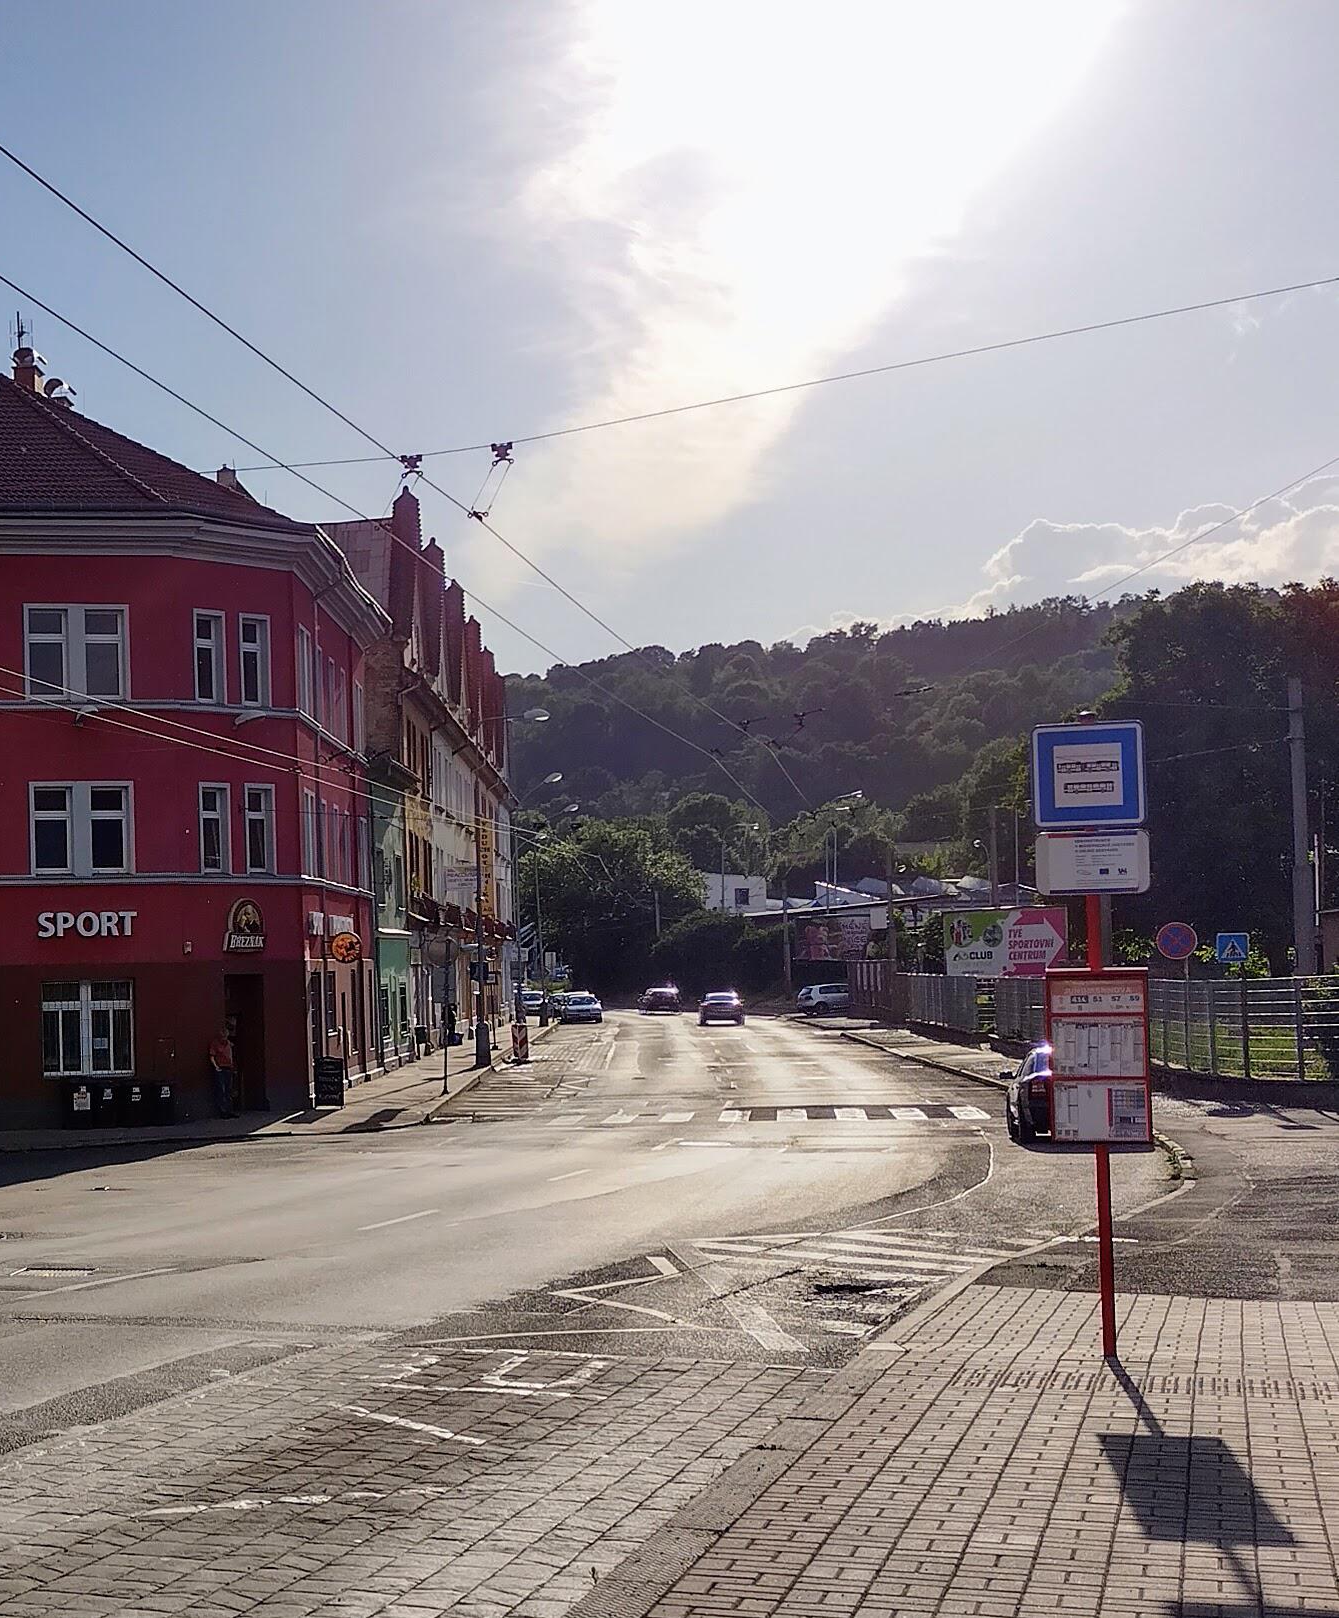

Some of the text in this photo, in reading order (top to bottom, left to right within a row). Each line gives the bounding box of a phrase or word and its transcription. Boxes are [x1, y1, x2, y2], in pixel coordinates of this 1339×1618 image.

[37, 911, 138, 938] SPORT
[969, 951, 994, 960] CLUB
[1008, 950, 1047, 961] CENTRUM
